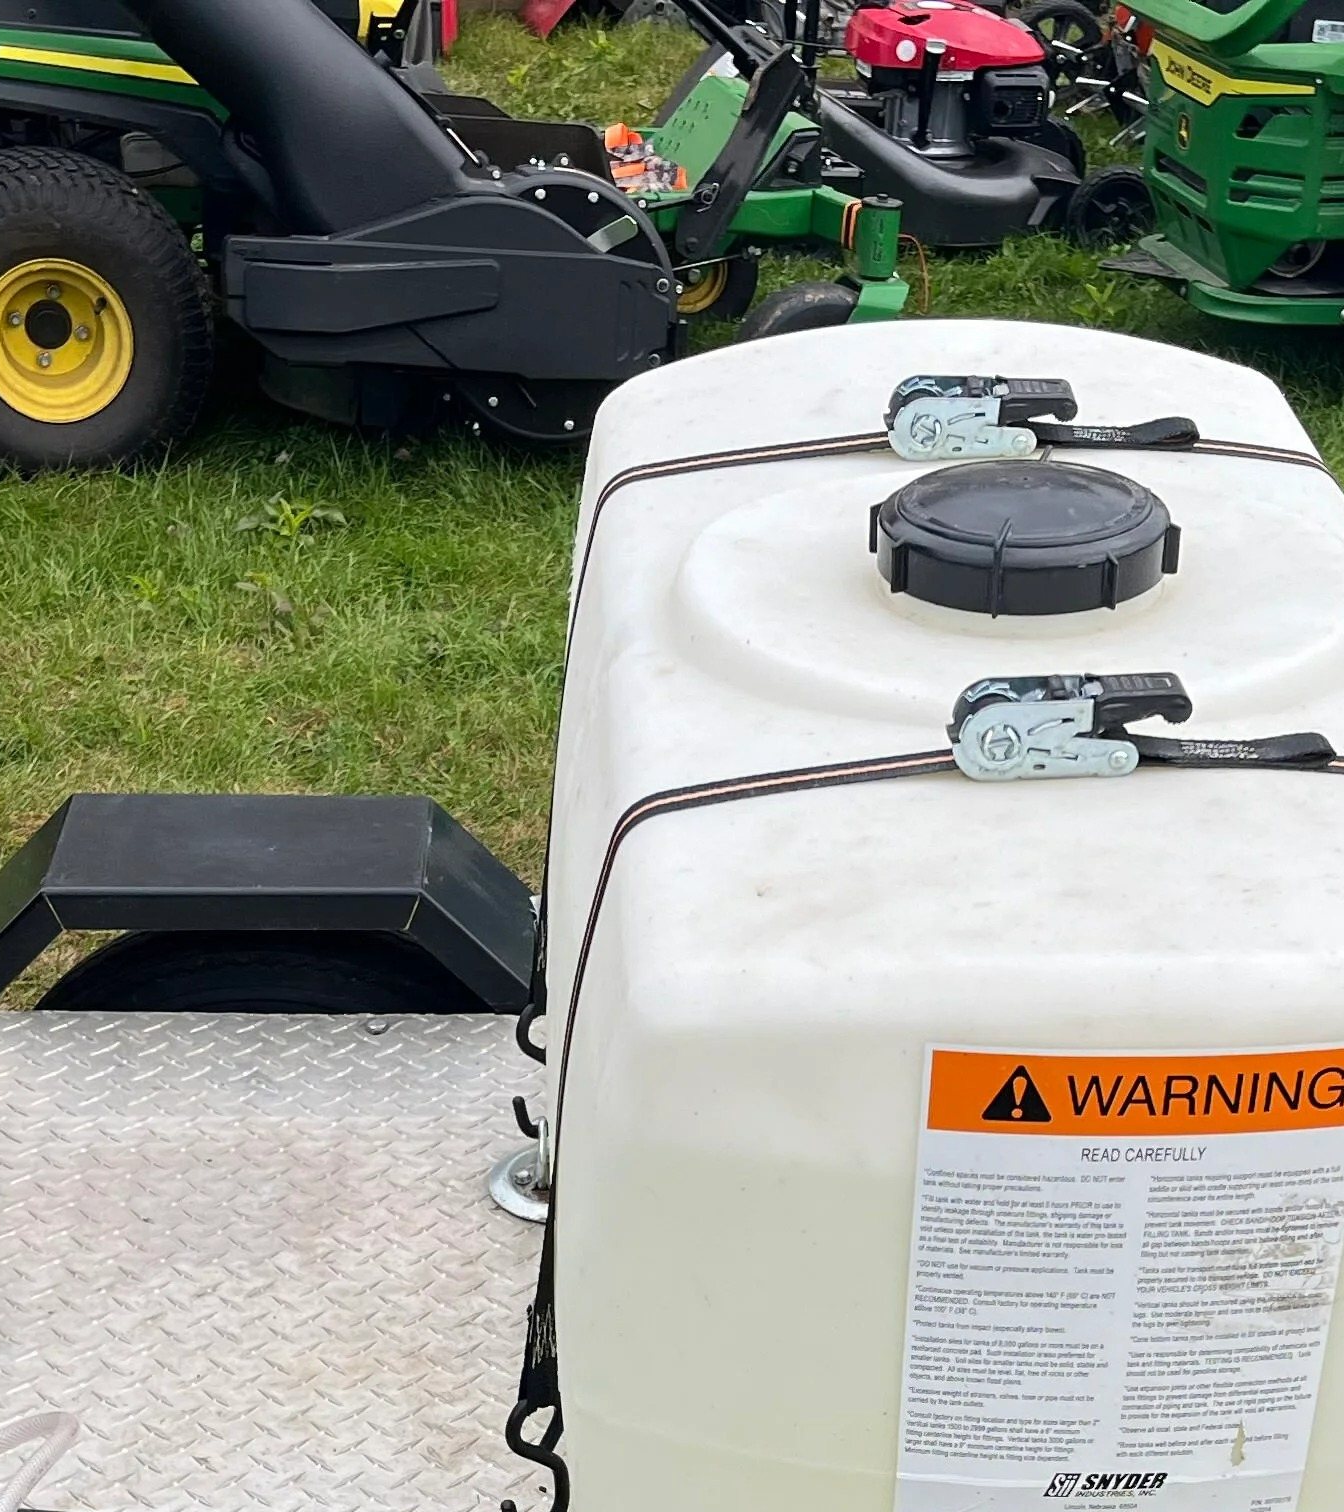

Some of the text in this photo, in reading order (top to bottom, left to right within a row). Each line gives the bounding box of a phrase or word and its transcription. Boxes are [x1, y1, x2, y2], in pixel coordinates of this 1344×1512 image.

[1081, 1145, 1208, 1163] READ CAREFULLY
[1081, 1472, 1169, 1490] SNYDER
